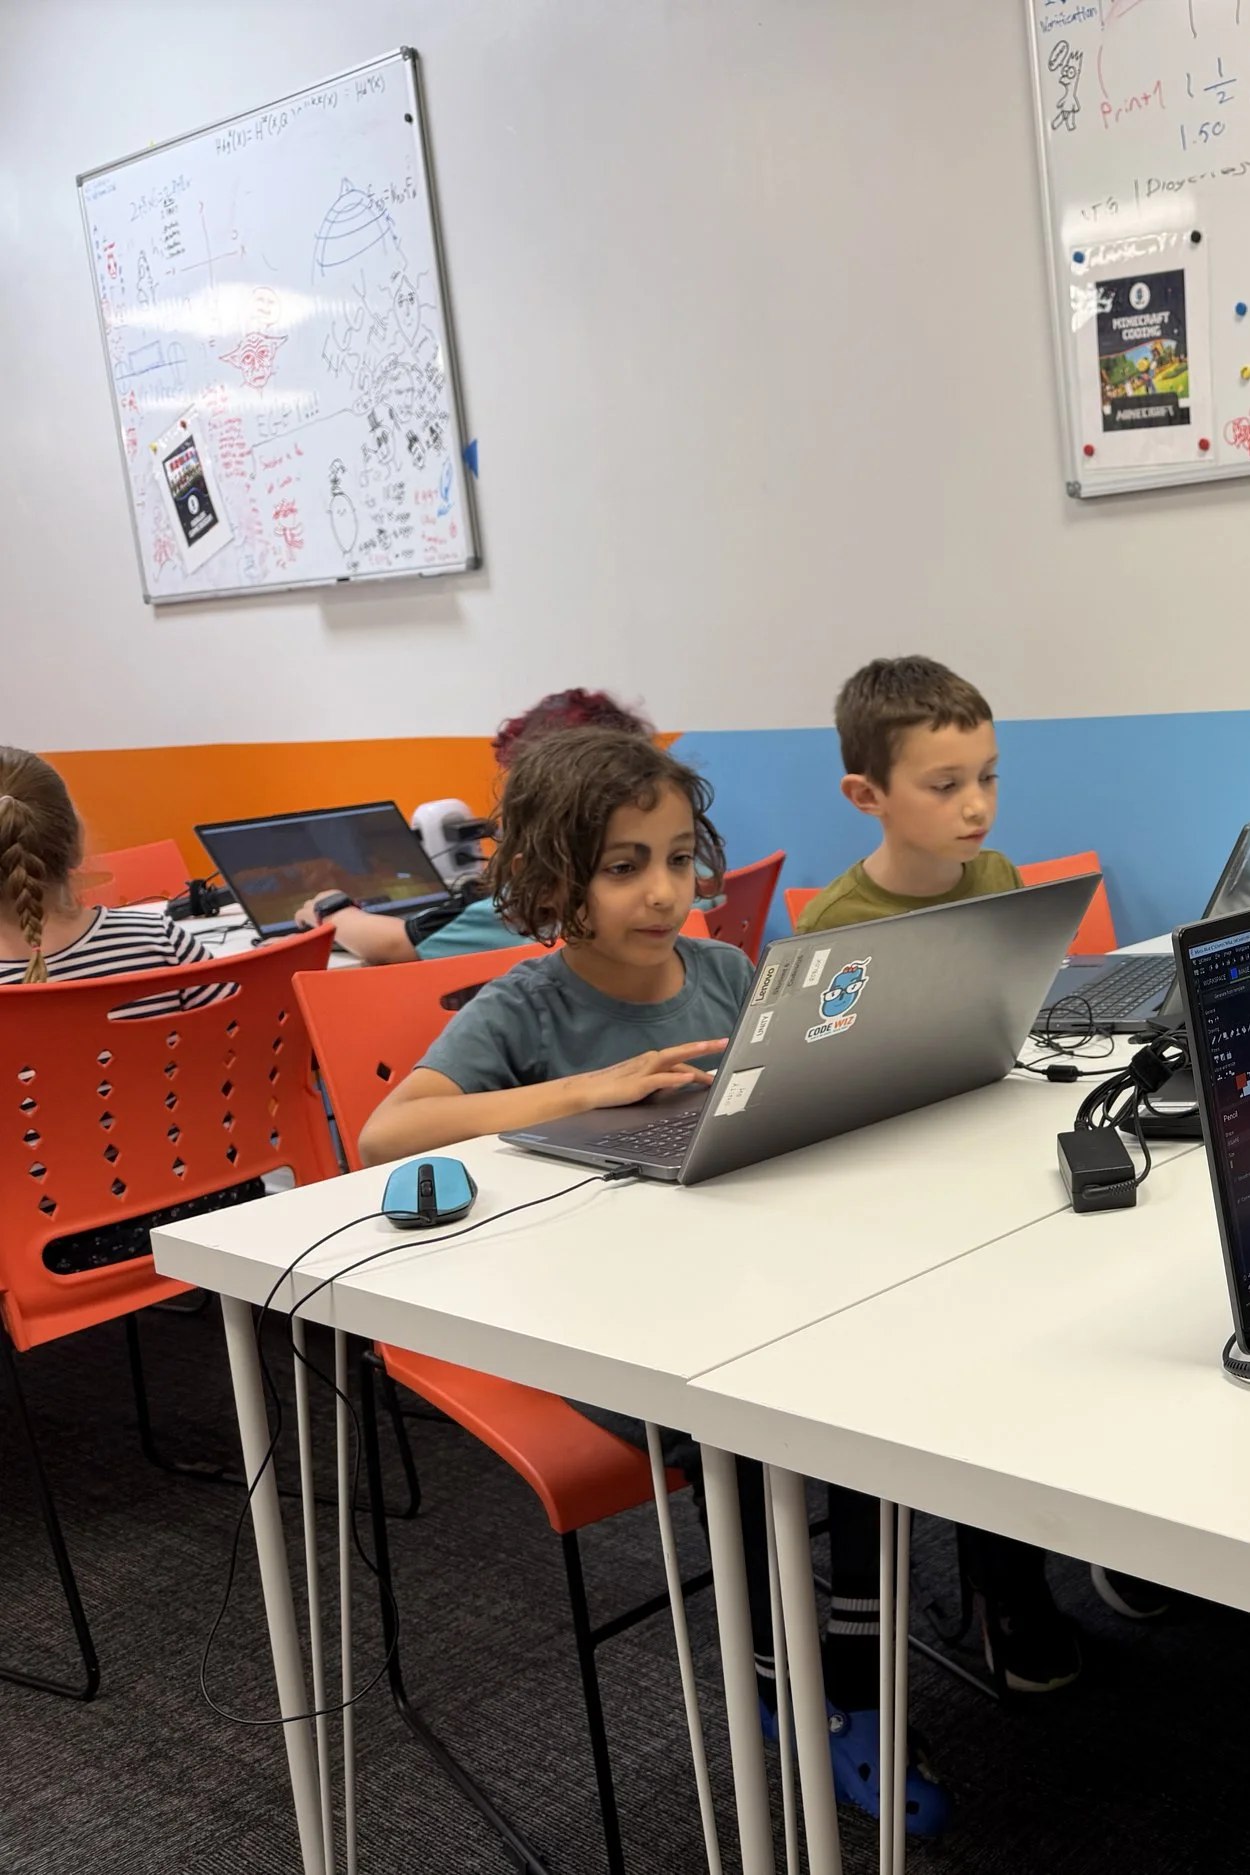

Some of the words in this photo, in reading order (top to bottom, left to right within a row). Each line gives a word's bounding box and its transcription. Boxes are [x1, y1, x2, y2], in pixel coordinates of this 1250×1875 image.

[1111, 311, 1171, 331] MINECRAFT
[1121, 325, 1163, 341] CODING
[755, 966, 776, 1002] Lenovo
[807, 1022, 834, 1038] CODE
[833, 1016, 855, 1029] WIZ
[1223, 1110, 1239, 1123] Pencil
